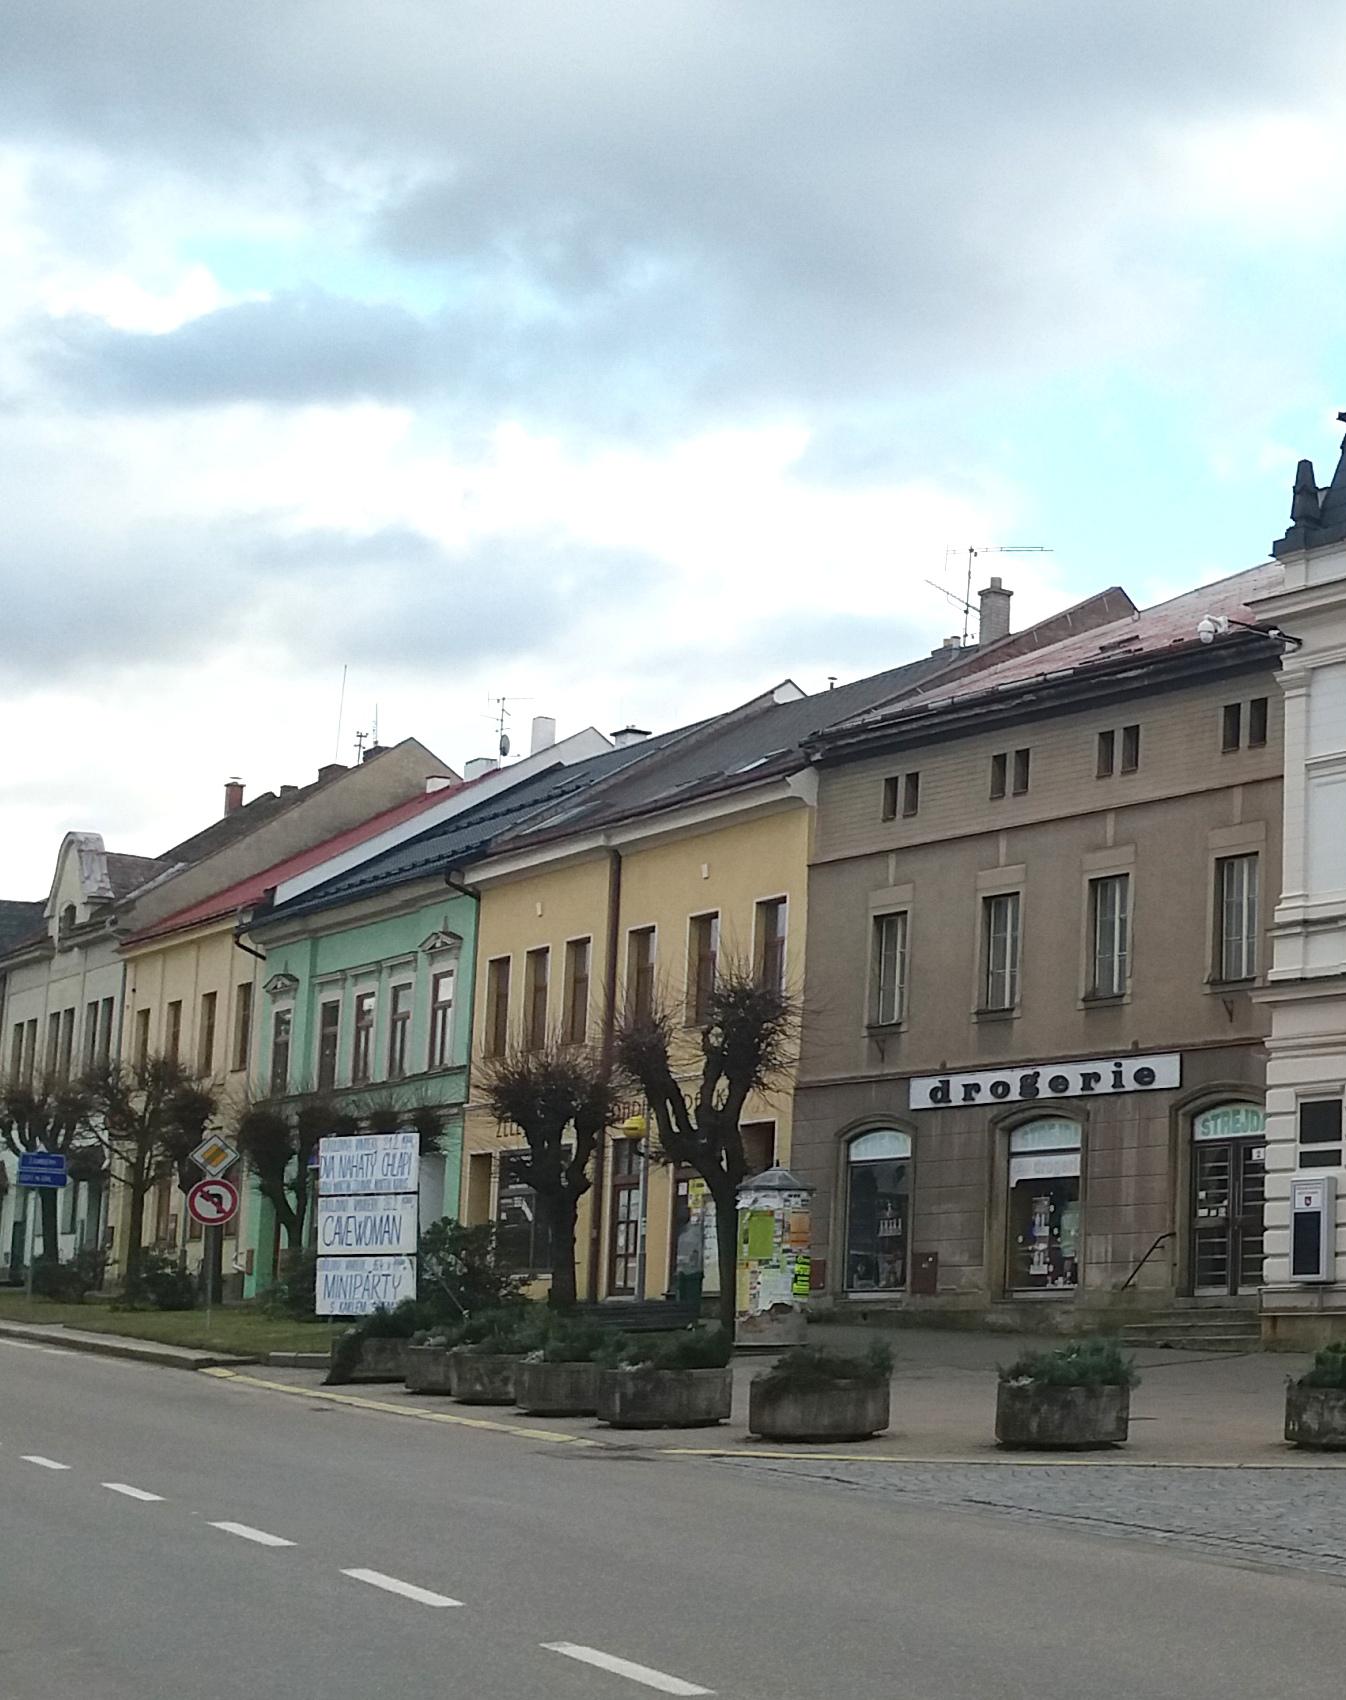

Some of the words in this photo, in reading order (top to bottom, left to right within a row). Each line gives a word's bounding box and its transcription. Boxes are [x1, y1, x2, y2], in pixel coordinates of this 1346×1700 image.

[928, 1061, 1156, 1104] drogerie
[1201, 1108, 1266, 1137] STREJD
[320, 1155, 335, 1179] DVA
[322, 1213, 402, 1247] CAVEWOMAN
[323, 1270, 402, 1300] MINIPÁRTY
